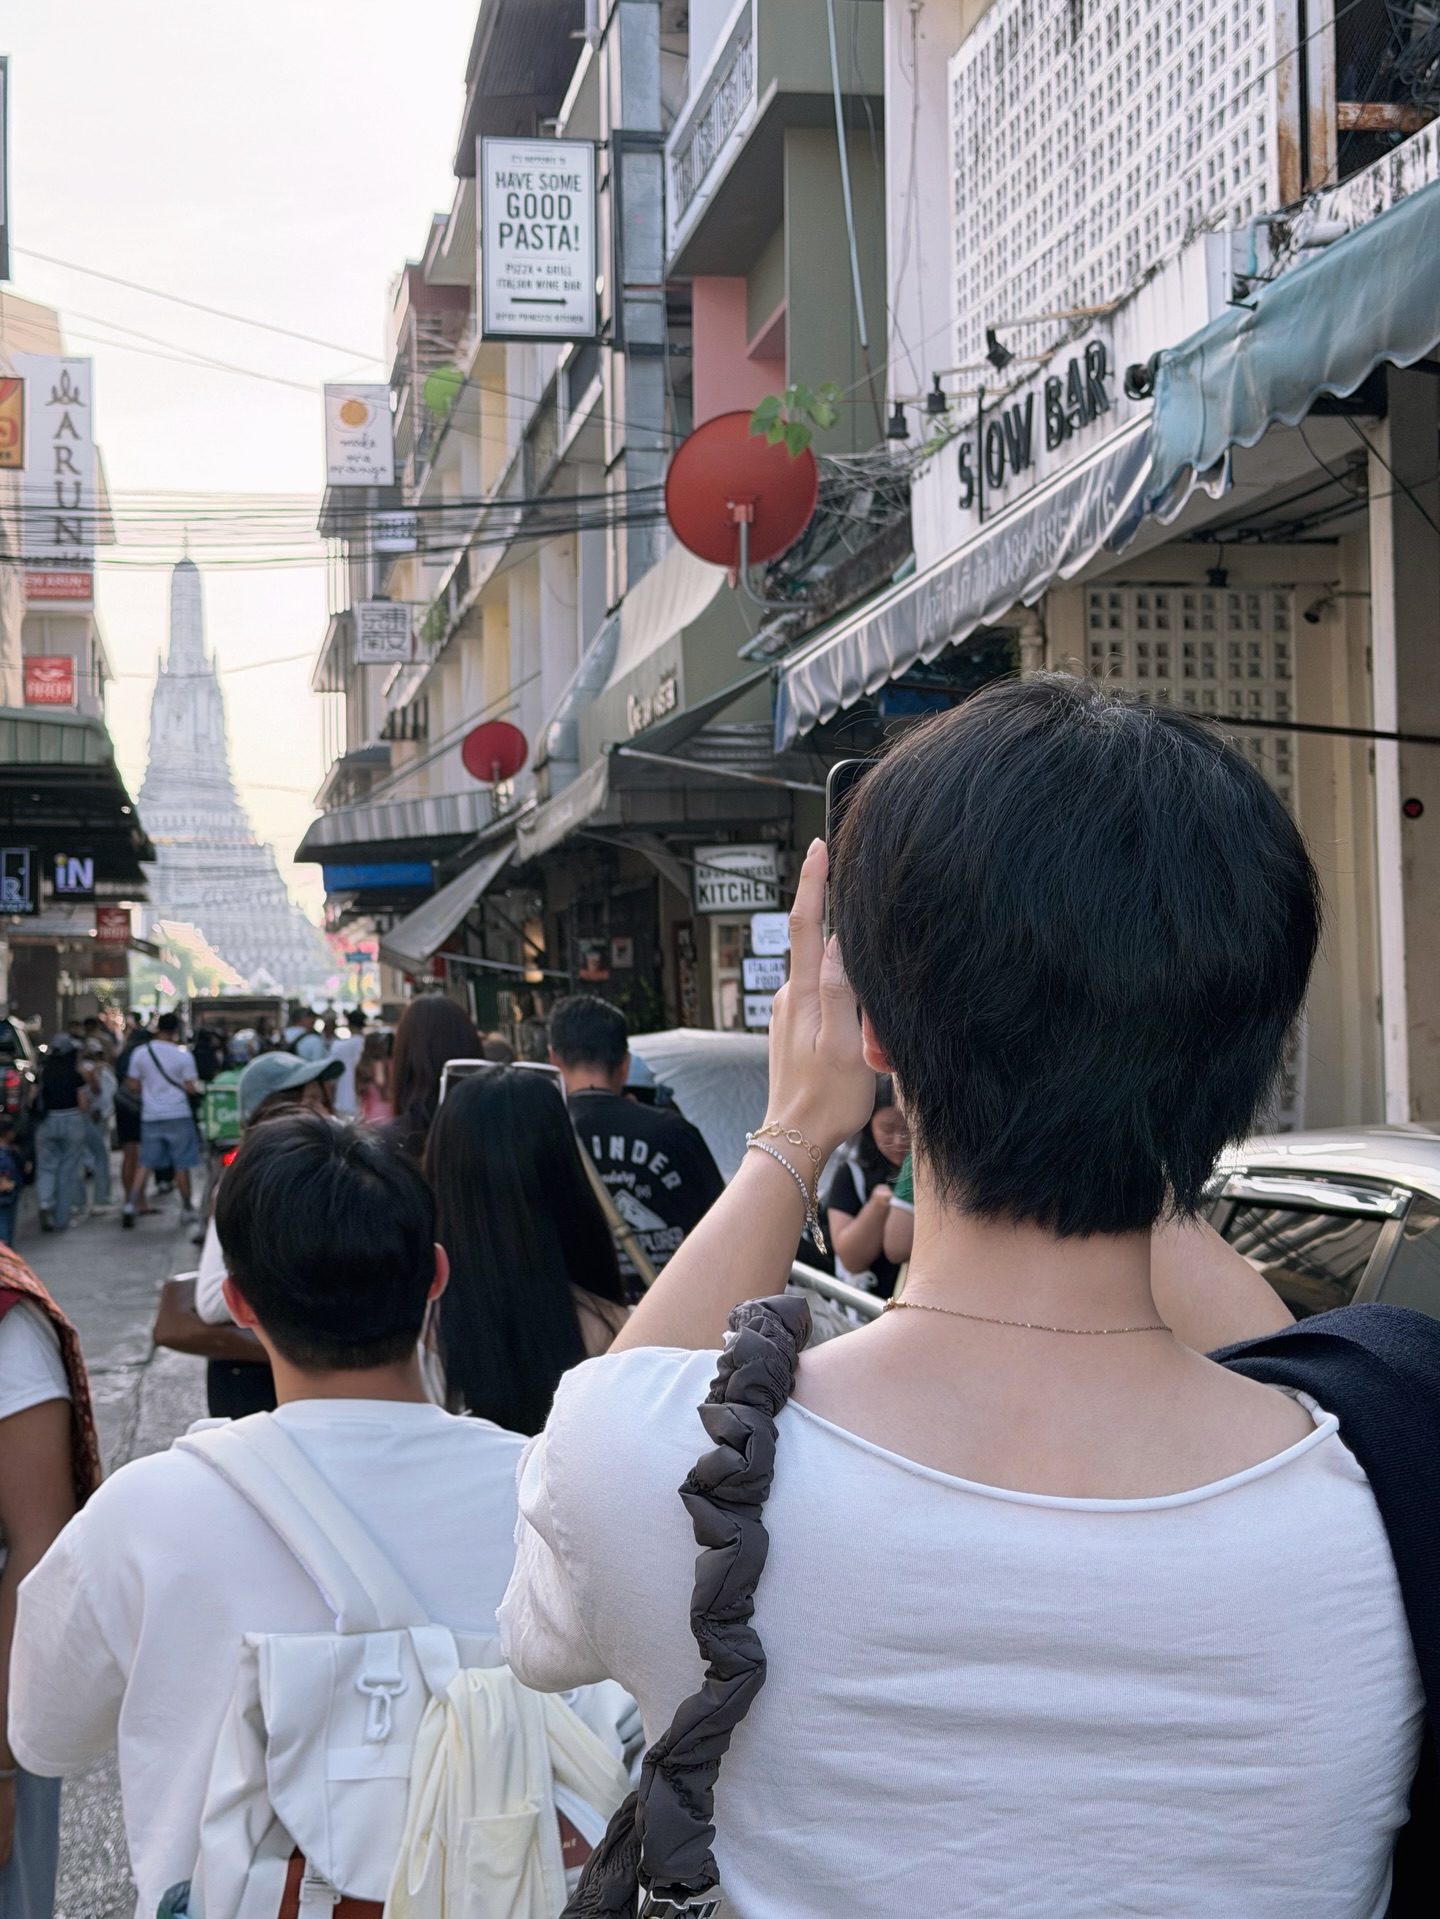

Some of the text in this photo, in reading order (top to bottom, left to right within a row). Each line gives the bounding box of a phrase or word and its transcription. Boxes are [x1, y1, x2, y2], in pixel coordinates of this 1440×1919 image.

[495, 171, 582, 192] HAVE SOME
[507, 192, 572, 220] GOOD
[499, 222, 580, 252] PASTA!
[1044, 339, 1111, 453] BAR
[53, 411, 82, 546] ARUN
[698, 881, 776, 904] KITCHEN
